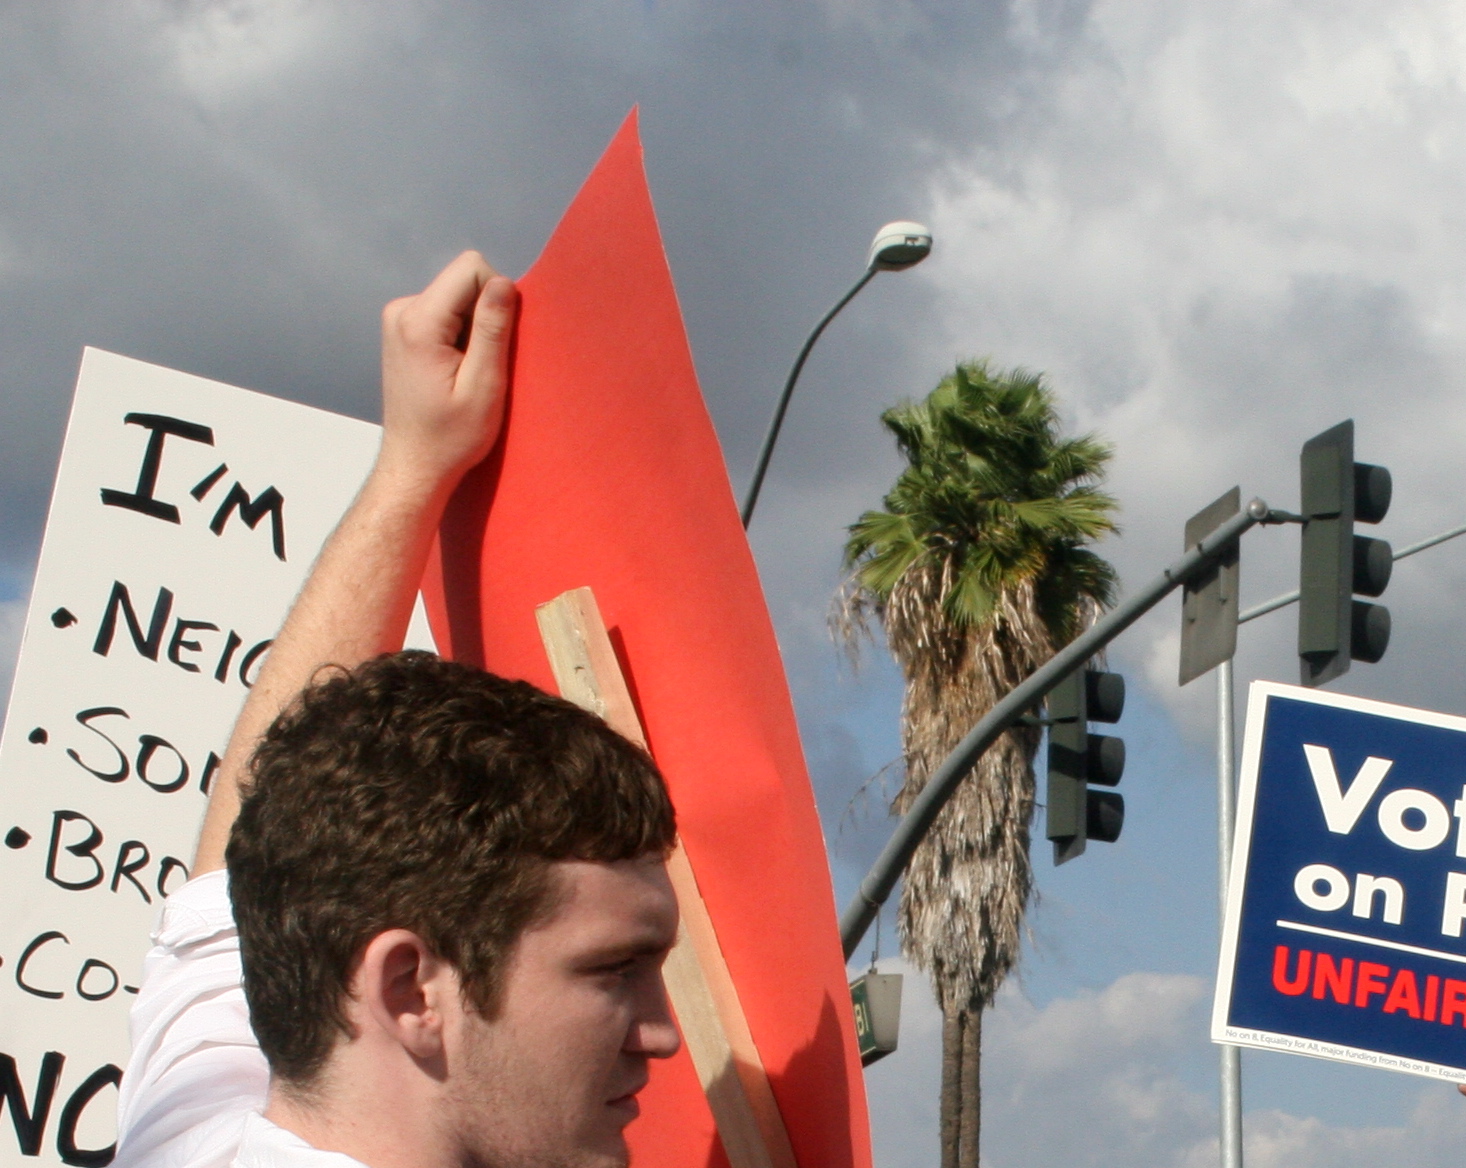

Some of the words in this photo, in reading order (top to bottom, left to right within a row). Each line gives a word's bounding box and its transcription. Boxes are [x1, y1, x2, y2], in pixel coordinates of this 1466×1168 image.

[100, 412, 287, 562] I'M
[1294, 864, 1404, 925] on
[1225, 1030, 1238, 1038] No
[1260, 1034, 1294, 1047] Equality
[1295, 1040, 1306, 1049] for
[1321, 1046, 1344, 1057] major
[1346, 1049, 1377, 1063] funding
[1378, 1056, 1397, 1067] from
[1399, 1059, 1411, 1069] No
